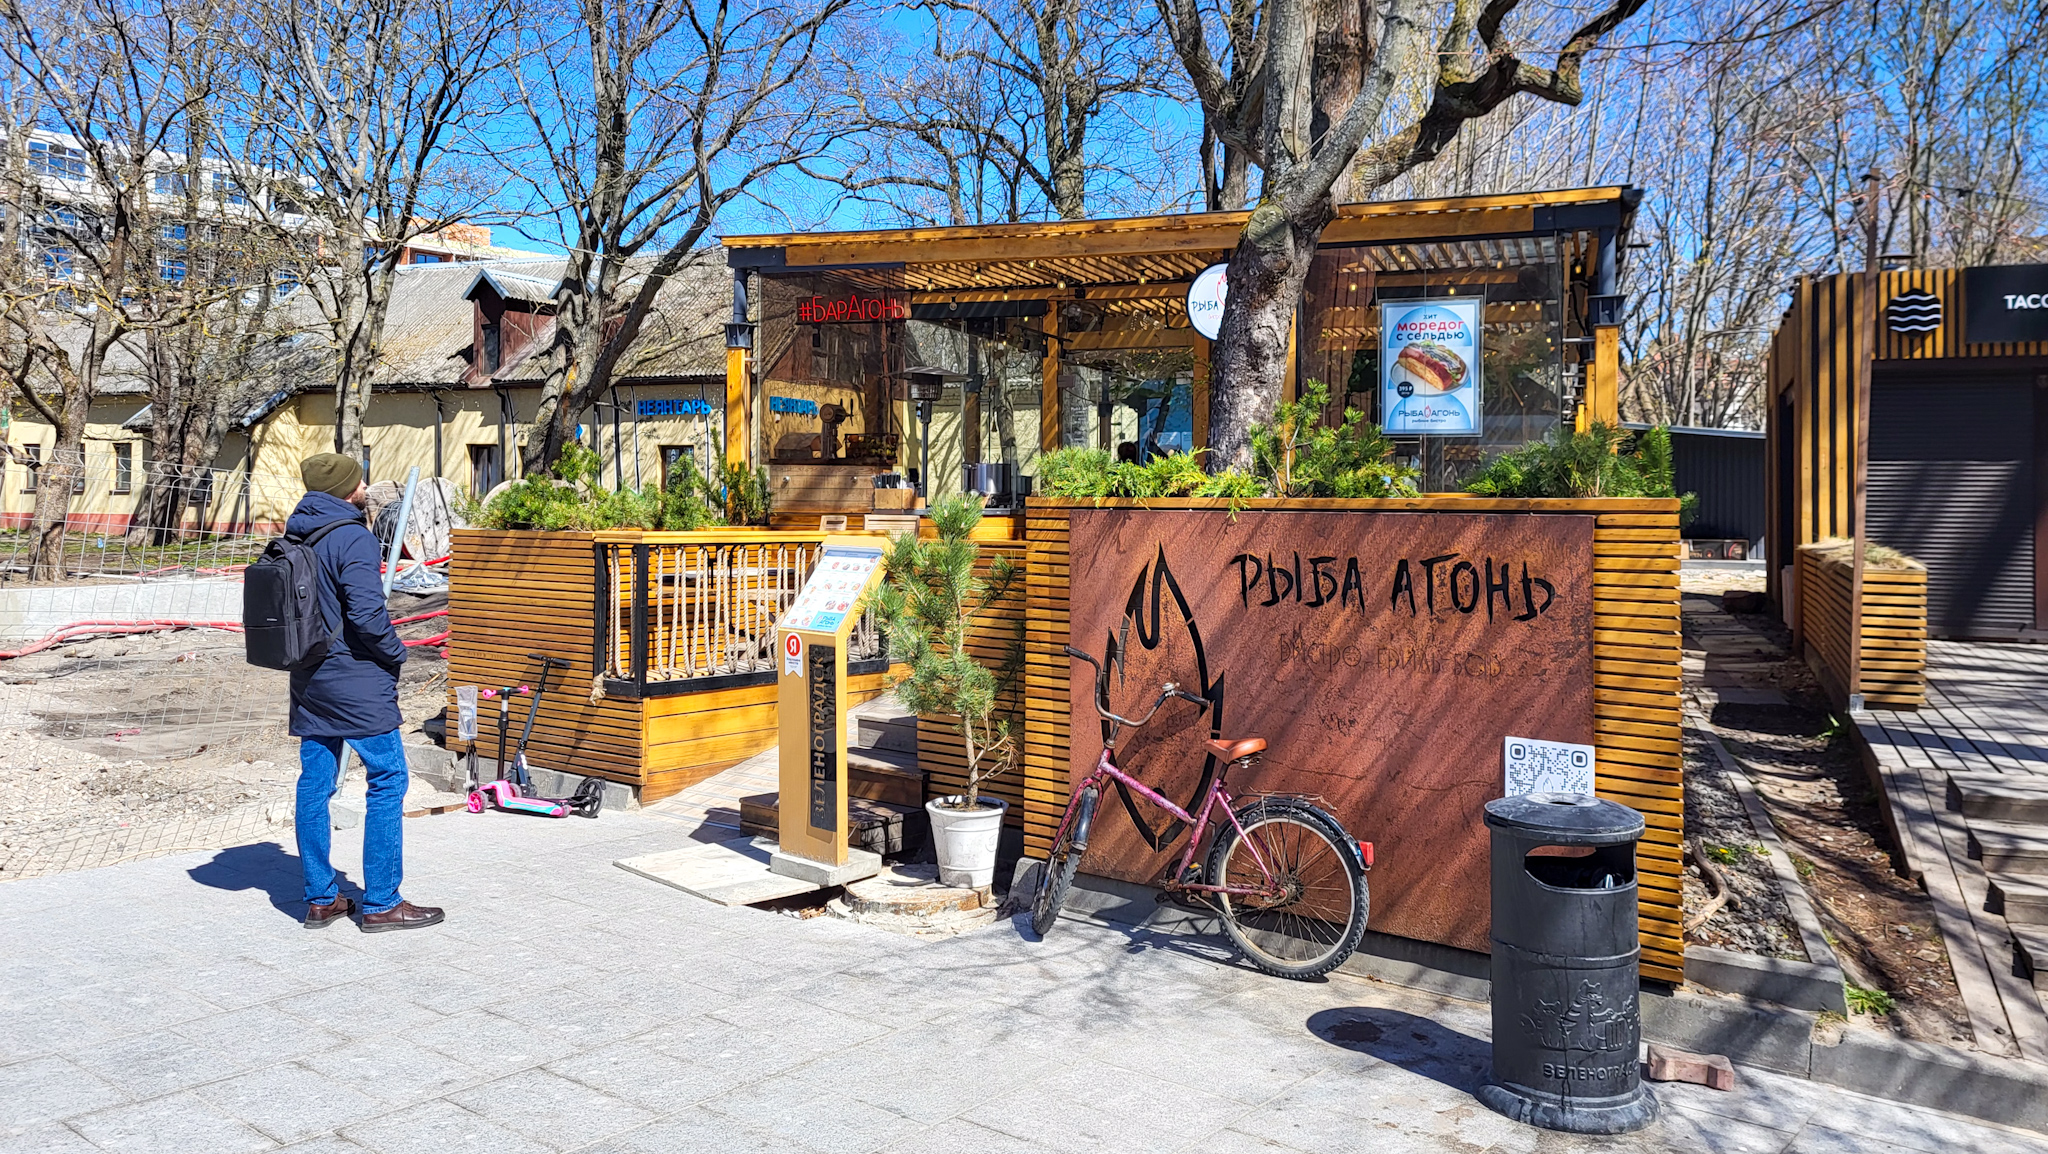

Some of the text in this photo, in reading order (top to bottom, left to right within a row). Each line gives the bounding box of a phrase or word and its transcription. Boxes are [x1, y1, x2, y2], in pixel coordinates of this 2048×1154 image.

[1191, 300, 1218, 311] РЫБА
[1397, 321, 1464, 334] моредог
[1407, 331, 1465, 341] сельдью
[638, 399, 712, 415] НЕЯНТАРЬ
[1230, 550, 1556, 625] РЫБА АГОНЬ
[790, 639, 797, 654] Я
[813, 656, 826, 819] ЗЕЛЕНОГРАДСК
